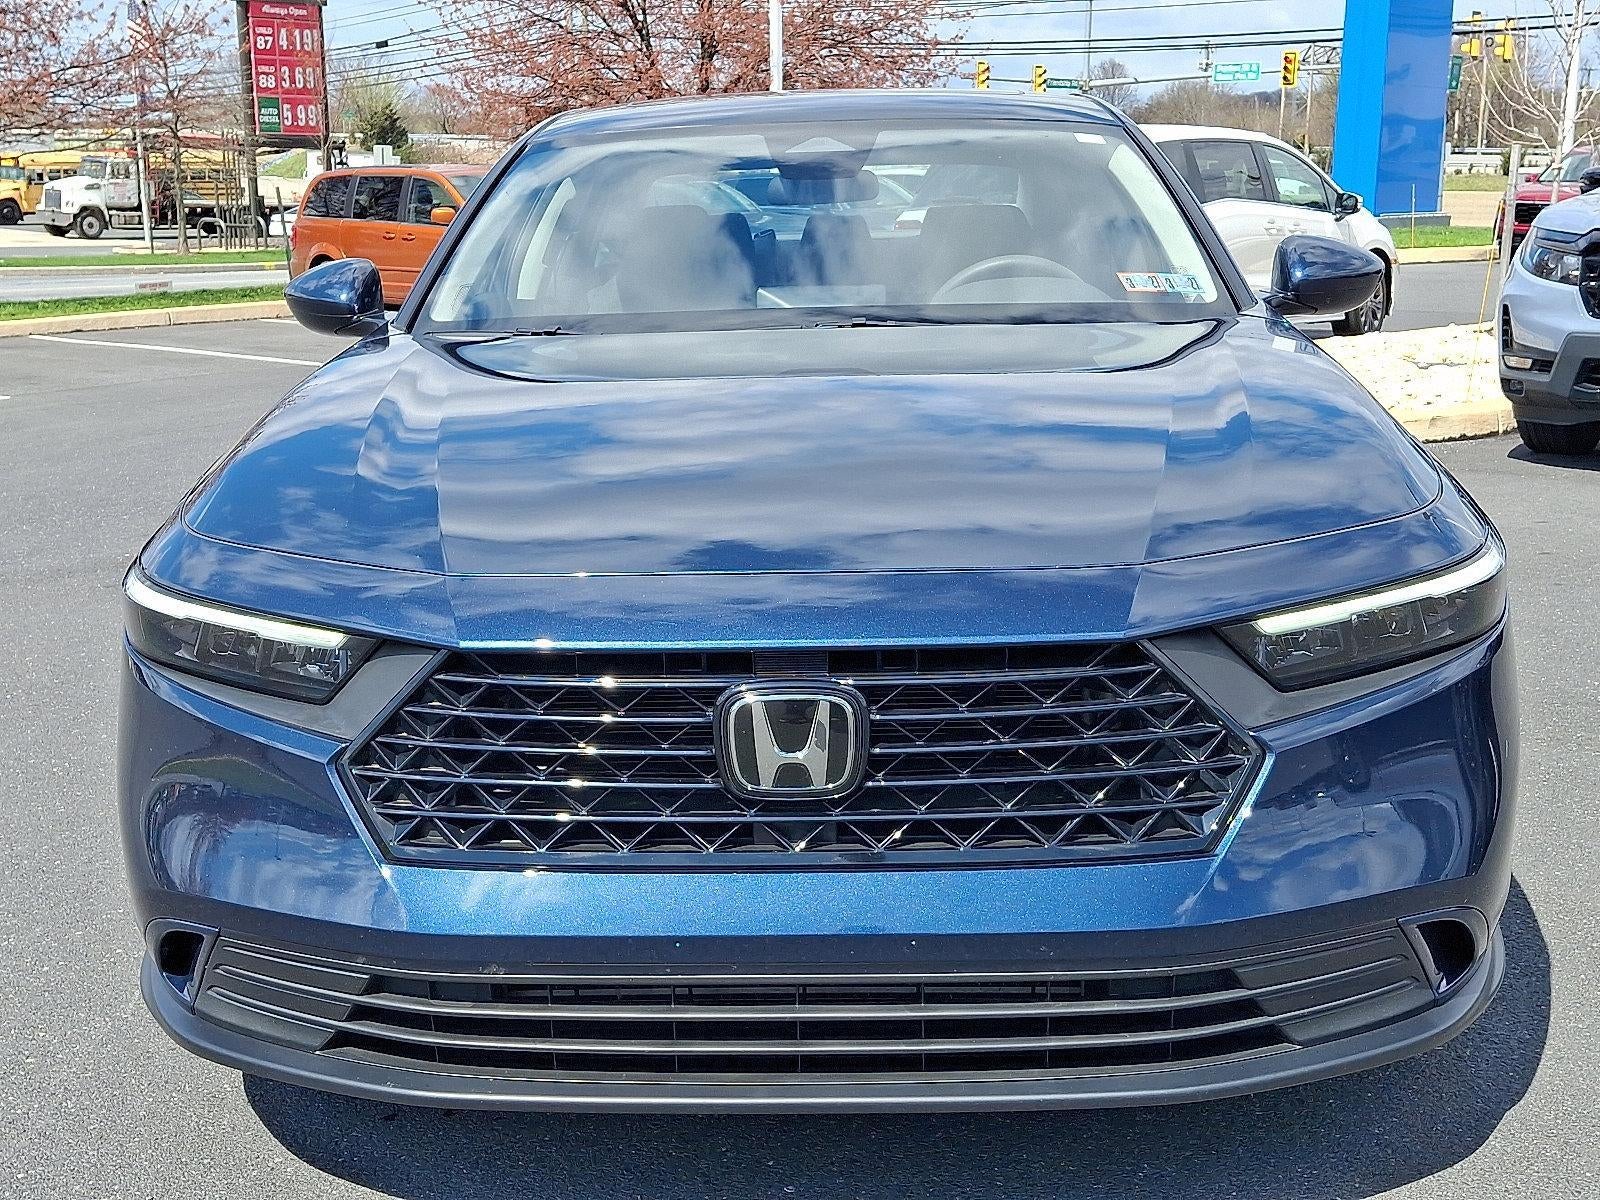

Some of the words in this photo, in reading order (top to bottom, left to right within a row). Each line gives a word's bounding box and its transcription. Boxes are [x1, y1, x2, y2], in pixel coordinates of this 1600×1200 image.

[289, 6, 308, 17] Open
[256, 36, 274, 50] 87
[259, 74, 276, 88] 88
[261, 107, 278, 115] AUTO
